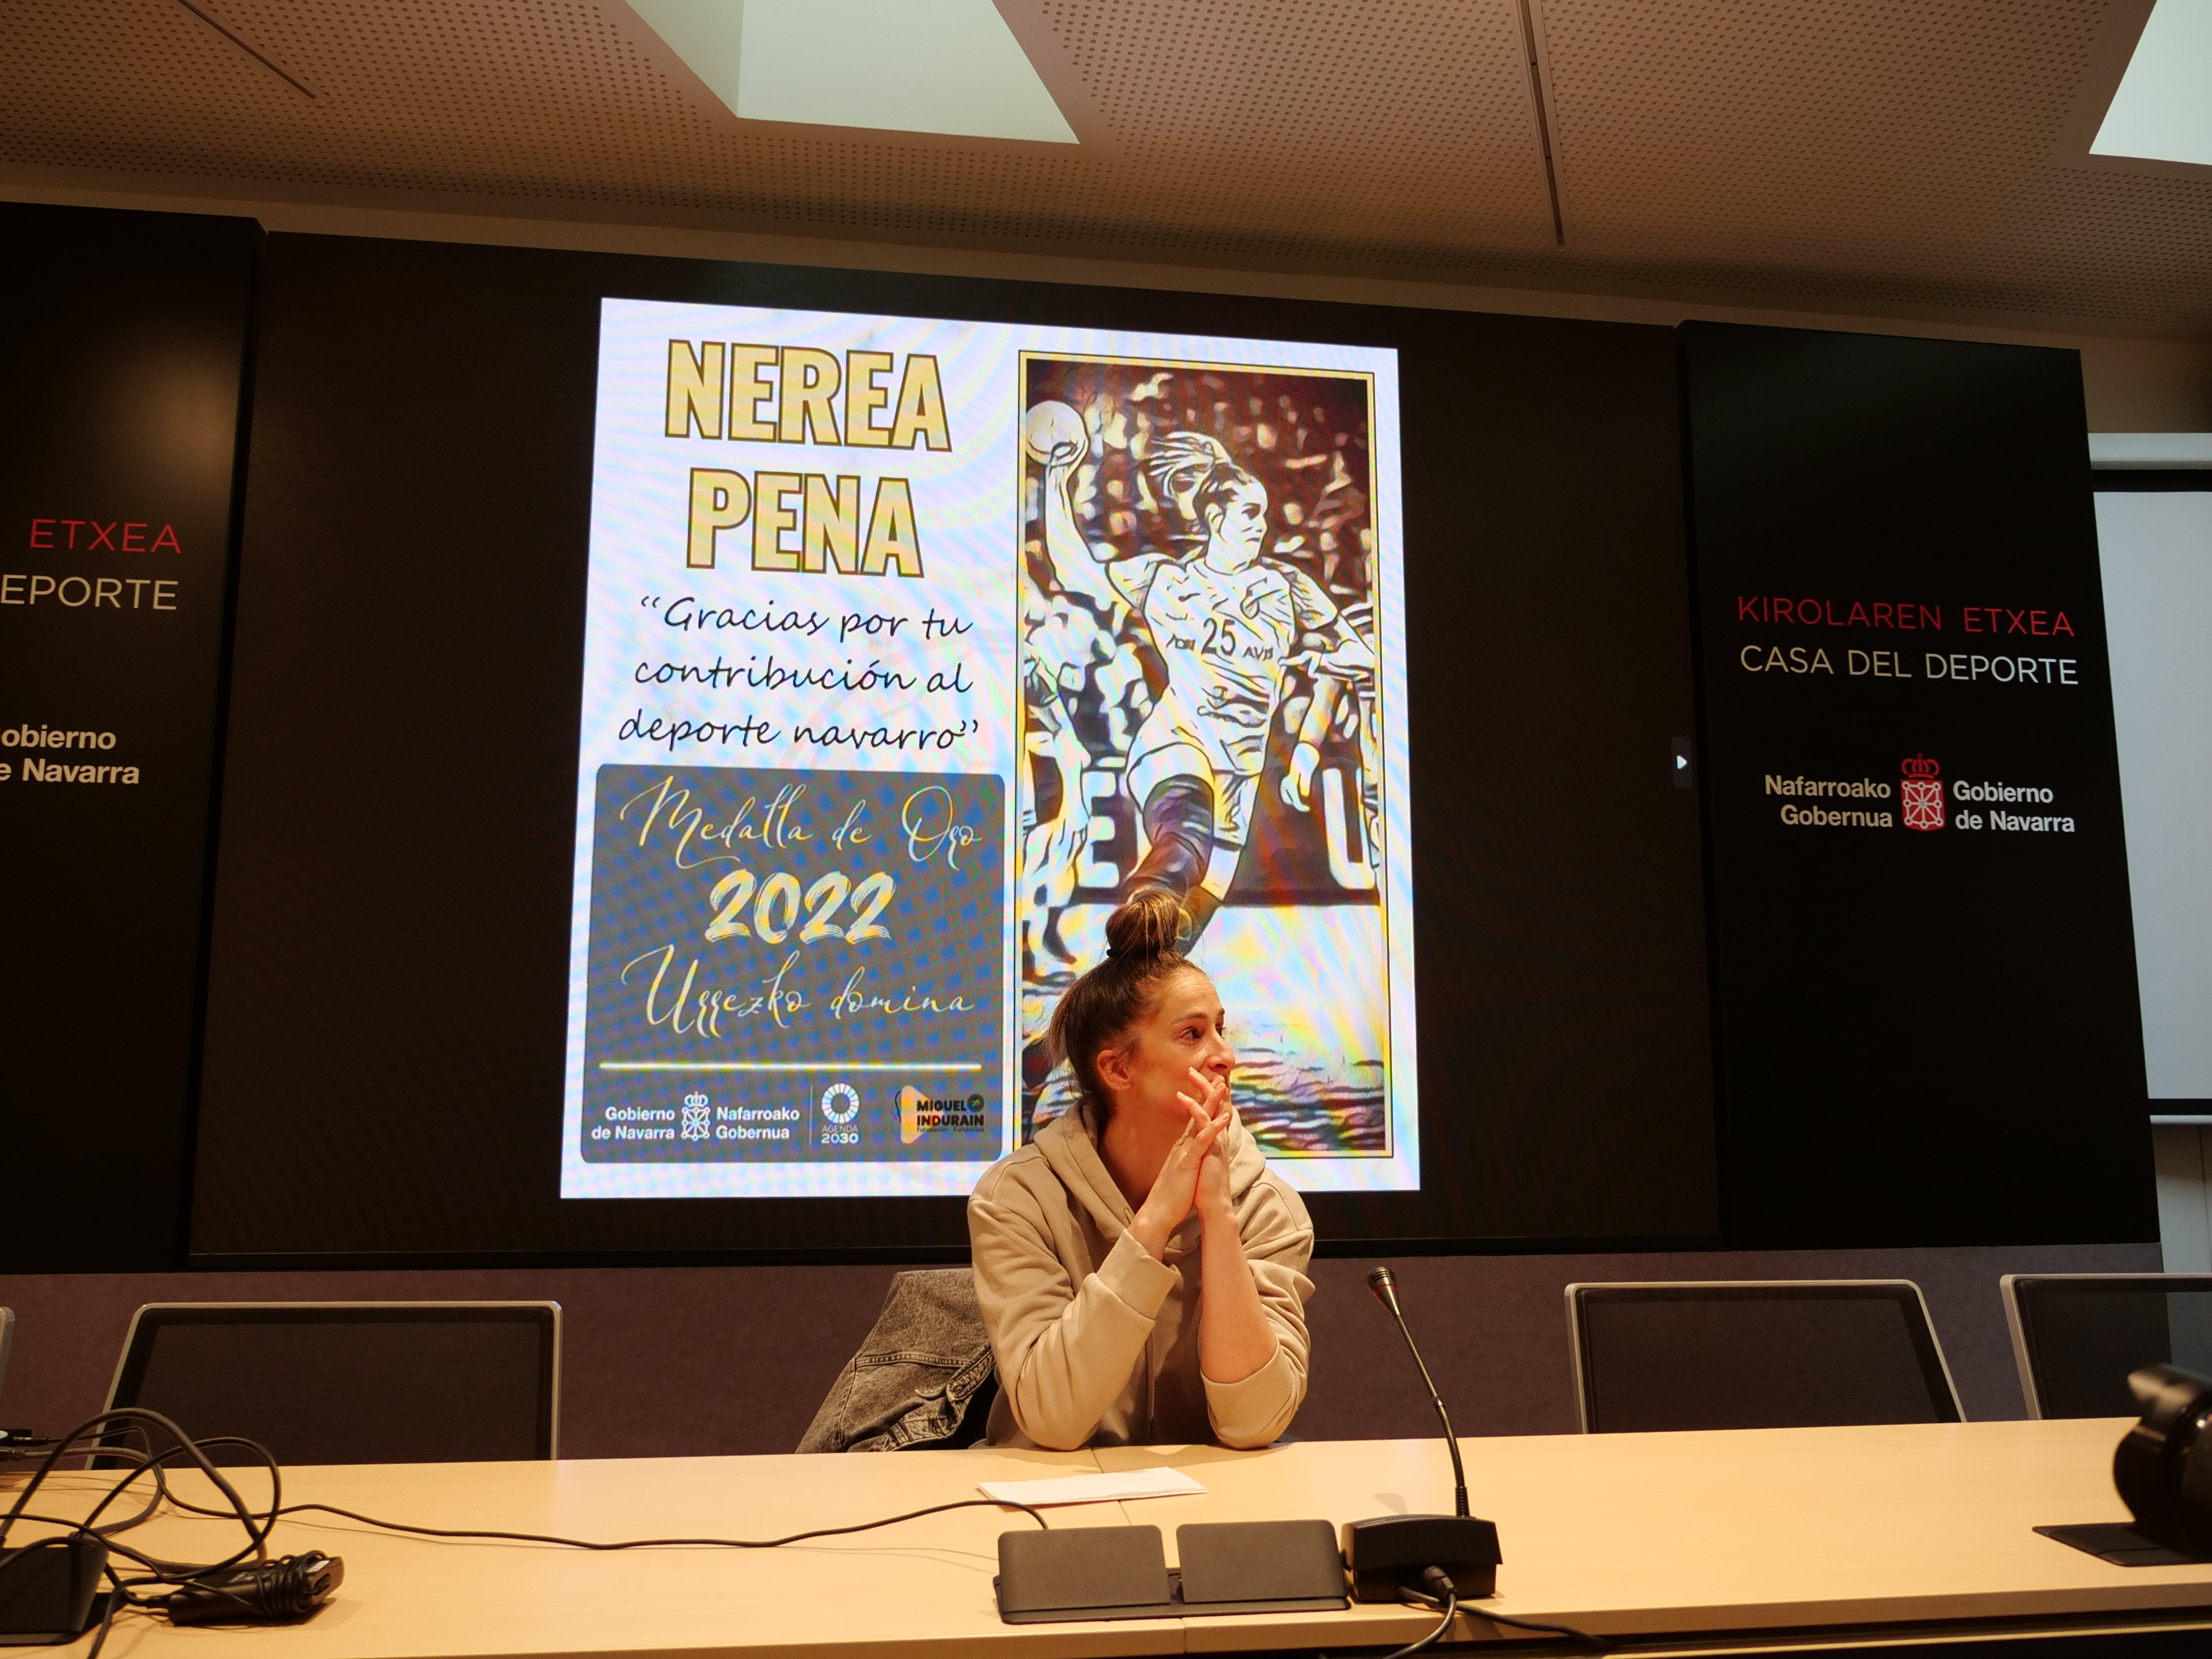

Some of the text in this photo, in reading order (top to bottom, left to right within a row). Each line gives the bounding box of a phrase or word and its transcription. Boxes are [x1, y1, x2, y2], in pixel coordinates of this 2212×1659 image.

[665, 339, 952, 452] NEREA
[686, 467, 924, 578] PENA
[30, 519, 182, 554] ETXEA
[0, 574, 179, 610] EPORTE
[641, 595, 973, 643] “Gracias por tu
[1737, 596, 2075, 637] KIROLAREN ETXEA
[1202, 618, 1235, 656] 25
[635, 655, 974, 693] contribución al
[1740, 644, 2079, 685] CASA DEL DEPORTE
[0, 724, 116, 750] obierno
[619, 709, 781, 751] deporte
[22, 758, 139, 784] Navarra
[1765, 775, 1891, 799] Nafarroako
[1953, 780, 2053, 804] Gobierno
[620, 775, 983, 871] Medalla de Oro
[1780, 805, 1893, 828] Gobernua
[1955, 810, 2075, 833] de Navarra
[704, 869, 896, 944] 2022
[830, 966, 975, 1020] domina
[604, 1106, 676, 1121] Gobierno
[716, 1106, 801, 1121] Nafarroako
[917, 1100, 967, 1111] MIGUEL
[591, 1125, 675, 1140] de Navarra
[715, 1125, 790, 1140] Gobernua
[821, 1125, 858, 1133] AGENDA
[917, 1114, 985, 1126] INDURAIN
[821, 1132, 860, 1144] 2030
